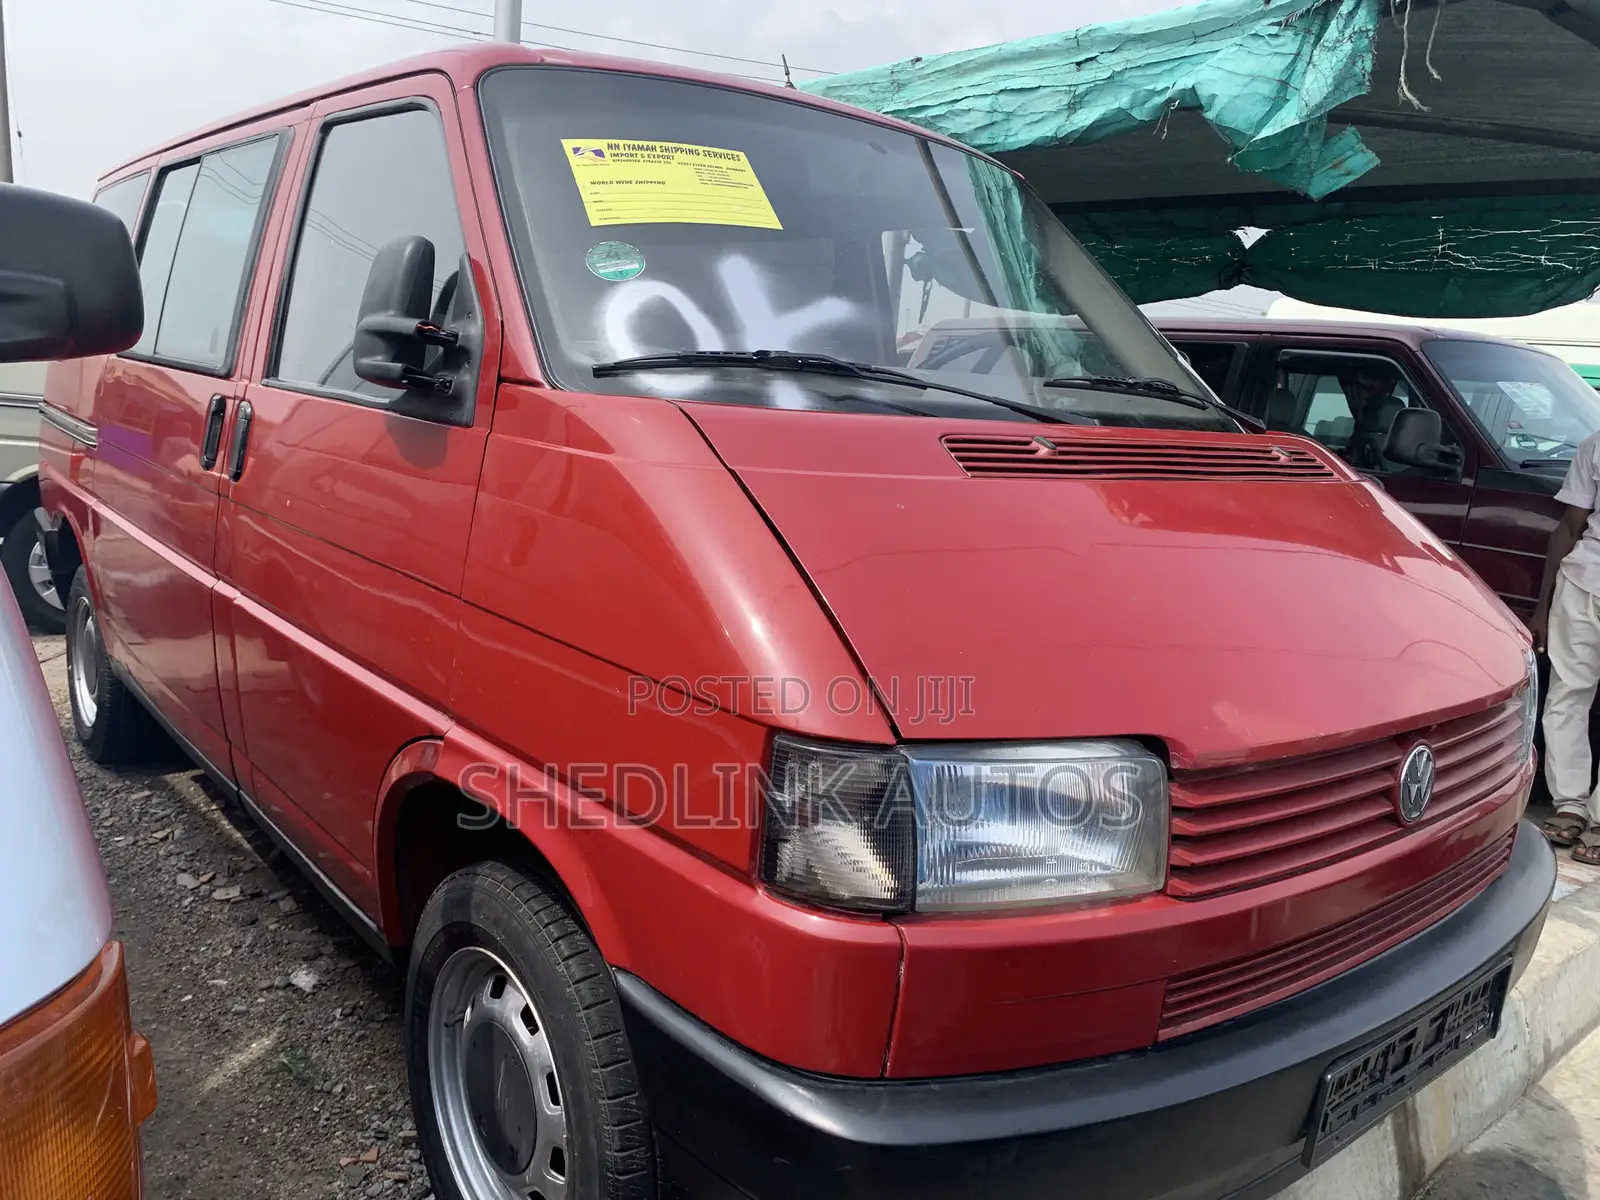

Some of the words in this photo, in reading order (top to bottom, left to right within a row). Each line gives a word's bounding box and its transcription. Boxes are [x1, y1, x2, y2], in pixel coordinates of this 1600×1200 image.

[607, 143, 620, 151] NN
[623, 143, 657, 153] IYAMAH
[659, 145, 700, 156] SHIPPING
[702, 149, 741, 162] SERVICES
[647, 153, 675, 161] EXPORT
[602, 253, 856, 411] OK
